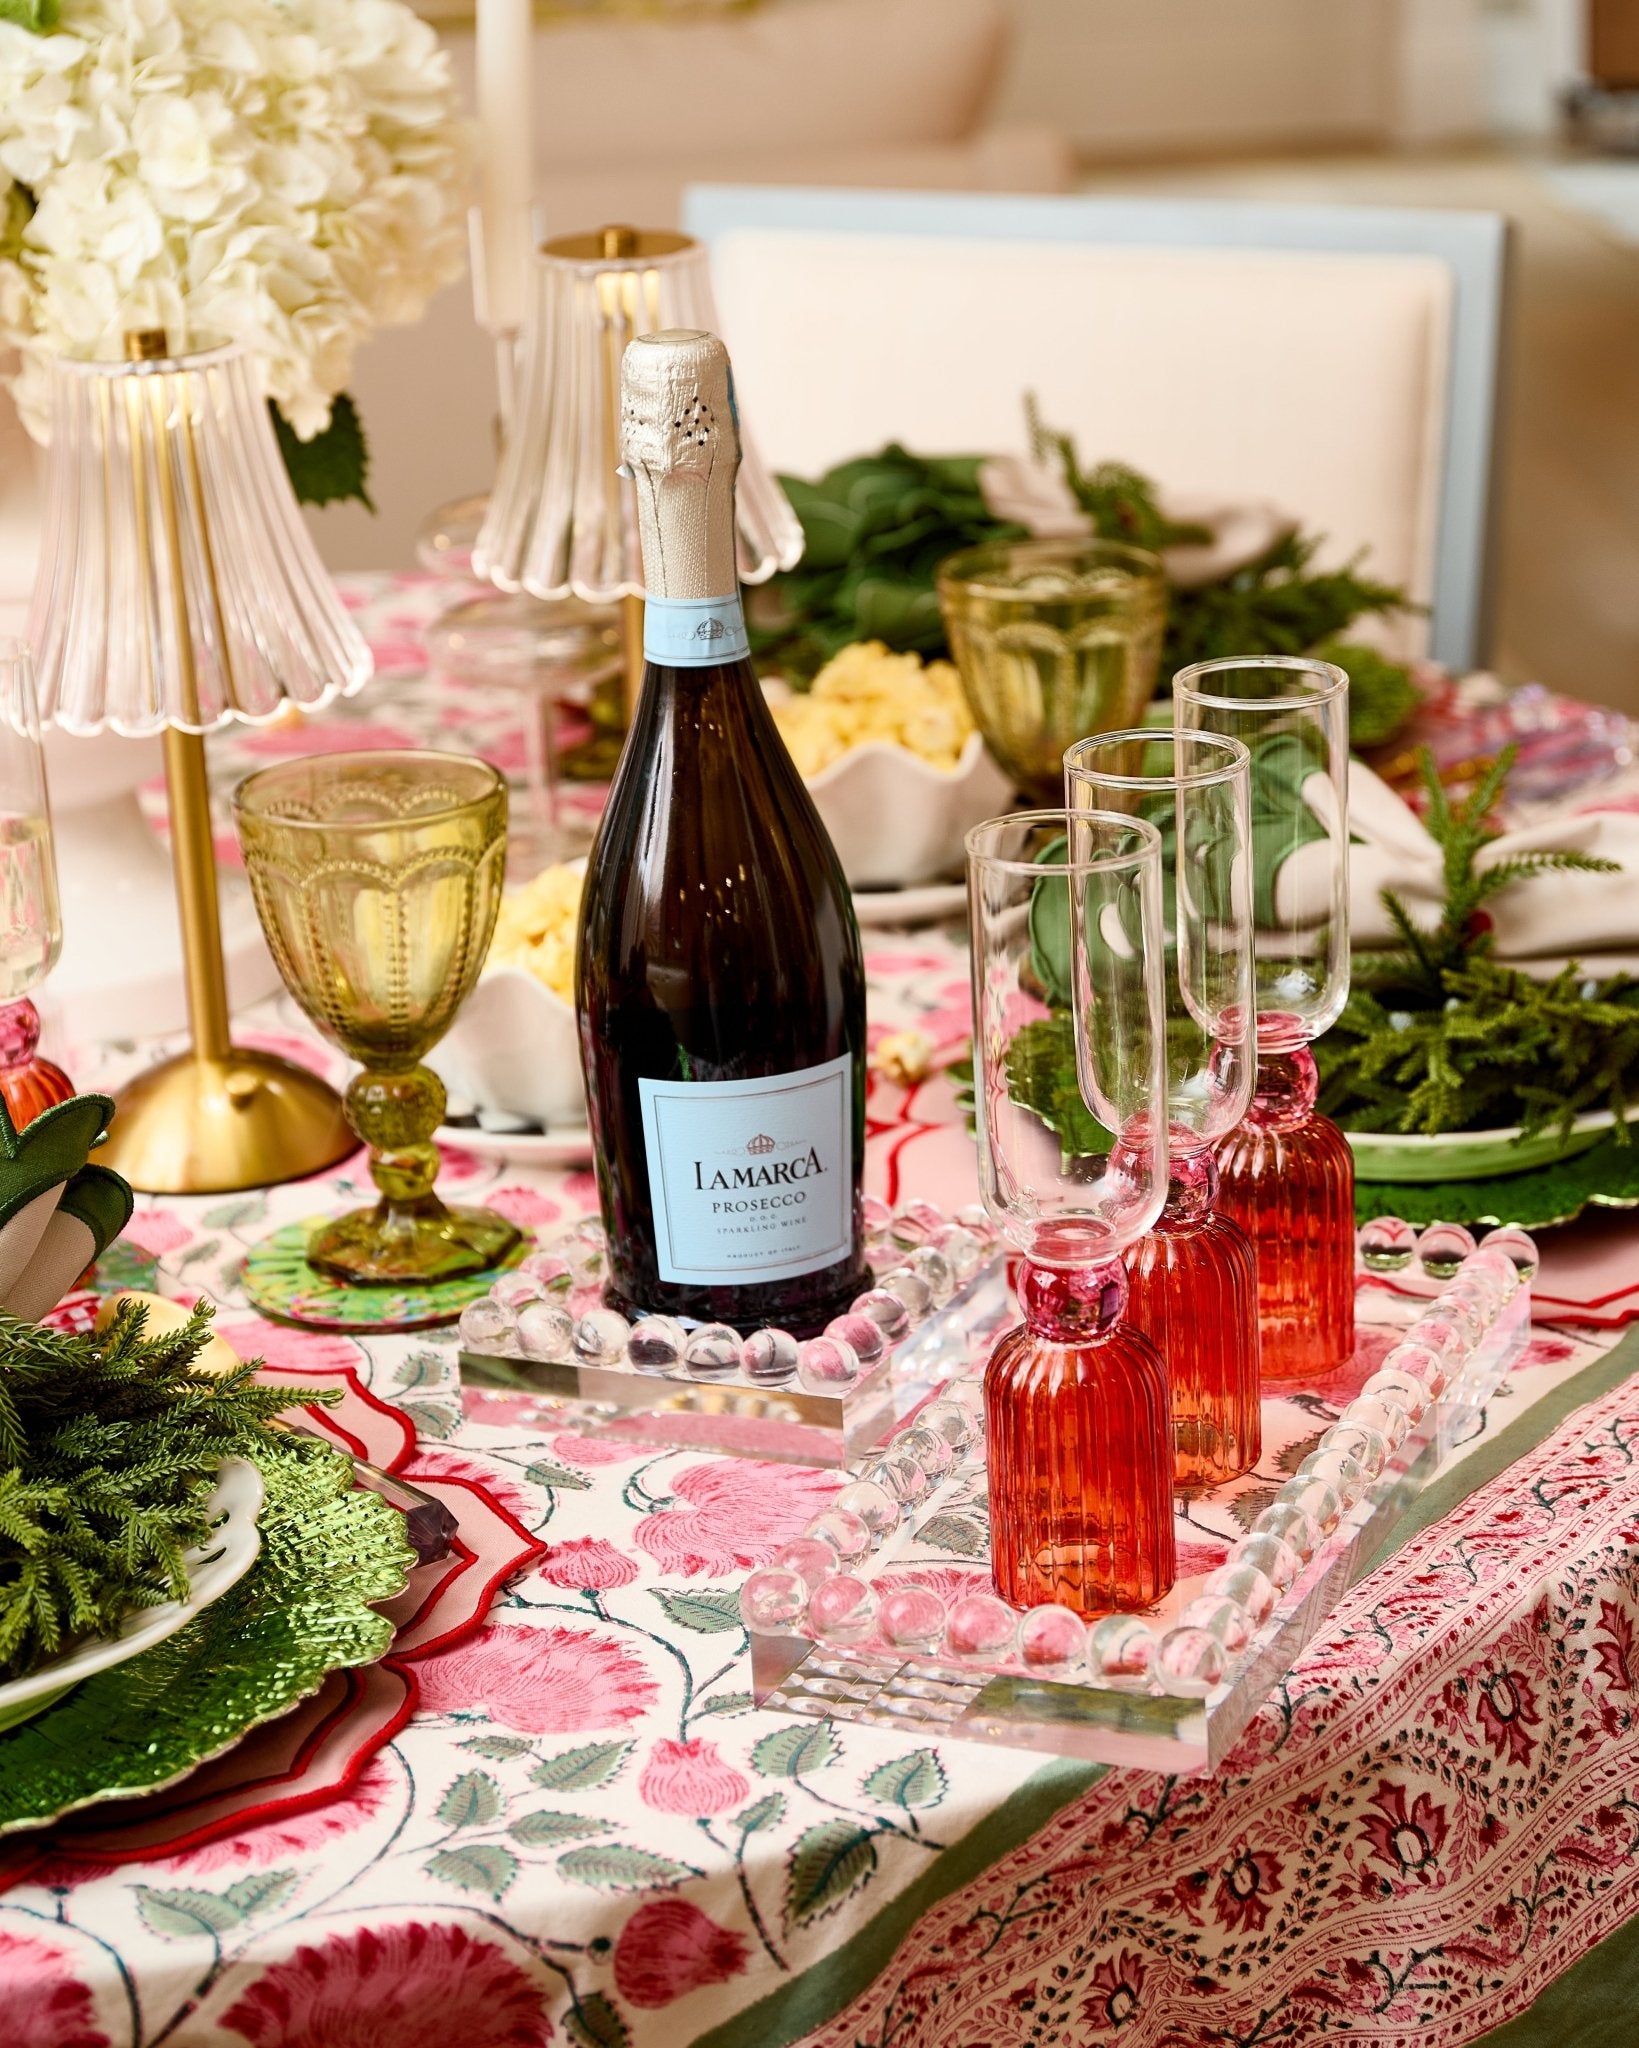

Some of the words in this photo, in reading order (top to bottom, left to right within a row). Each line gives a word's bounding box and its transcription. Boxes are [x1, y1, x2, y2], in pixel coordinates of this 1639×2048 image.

[712, 1191, 806, 1213] PROSECCO
[717, 1223, 776, 1234] SPARKLING
[781, 1216, 806, 1227] WINE
